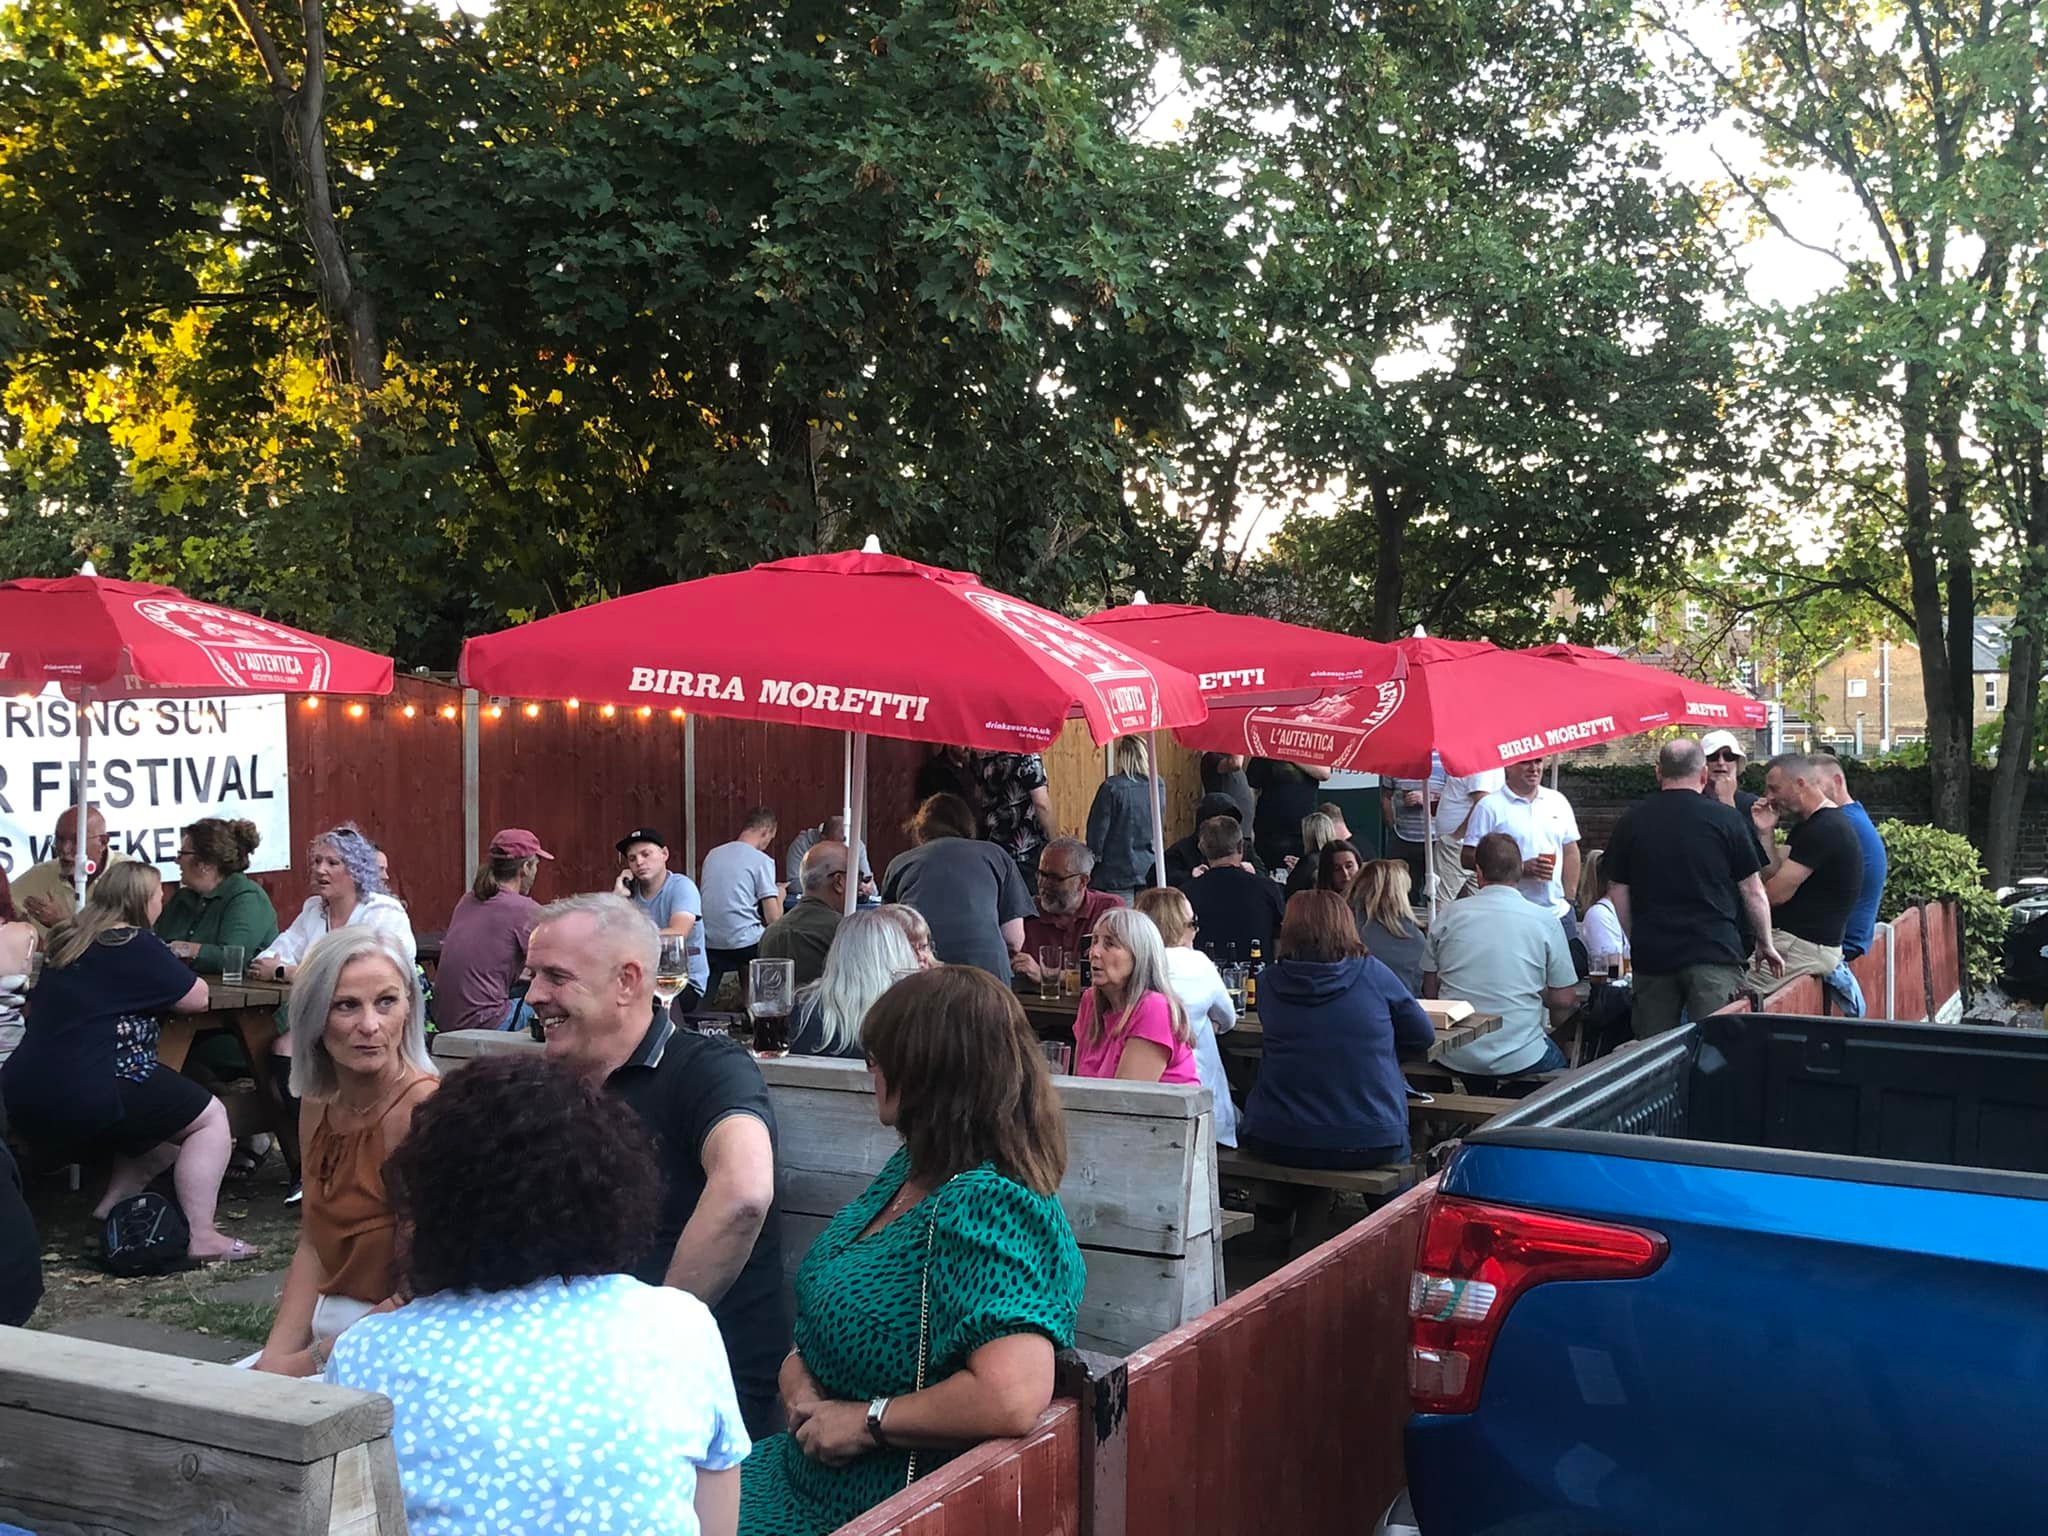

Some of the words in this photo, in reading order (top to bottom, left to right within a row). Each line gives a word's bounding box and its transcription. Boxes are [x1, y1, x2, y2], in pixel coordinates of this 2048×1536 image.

[233, 652, 303, 675] L'AUTENTICA
[629, 667, 745, 701] BIRRA
[758, 679, 929, 721] MORETTI
[1199, 668, 1264, 690] ETTI
[6, 700, 140, 737] RISING
[156, 700, 227, 735] SUN
[1686, 702, 1728, 718] ORETTI
[1270, 728, 1334, 751] L'AUTENTICA
[1498, 734, 1544, 759] BIRRA
[1545, 716, 1615, 746] MORETTI
[33, 754, 274, 812] FESTIVAL
